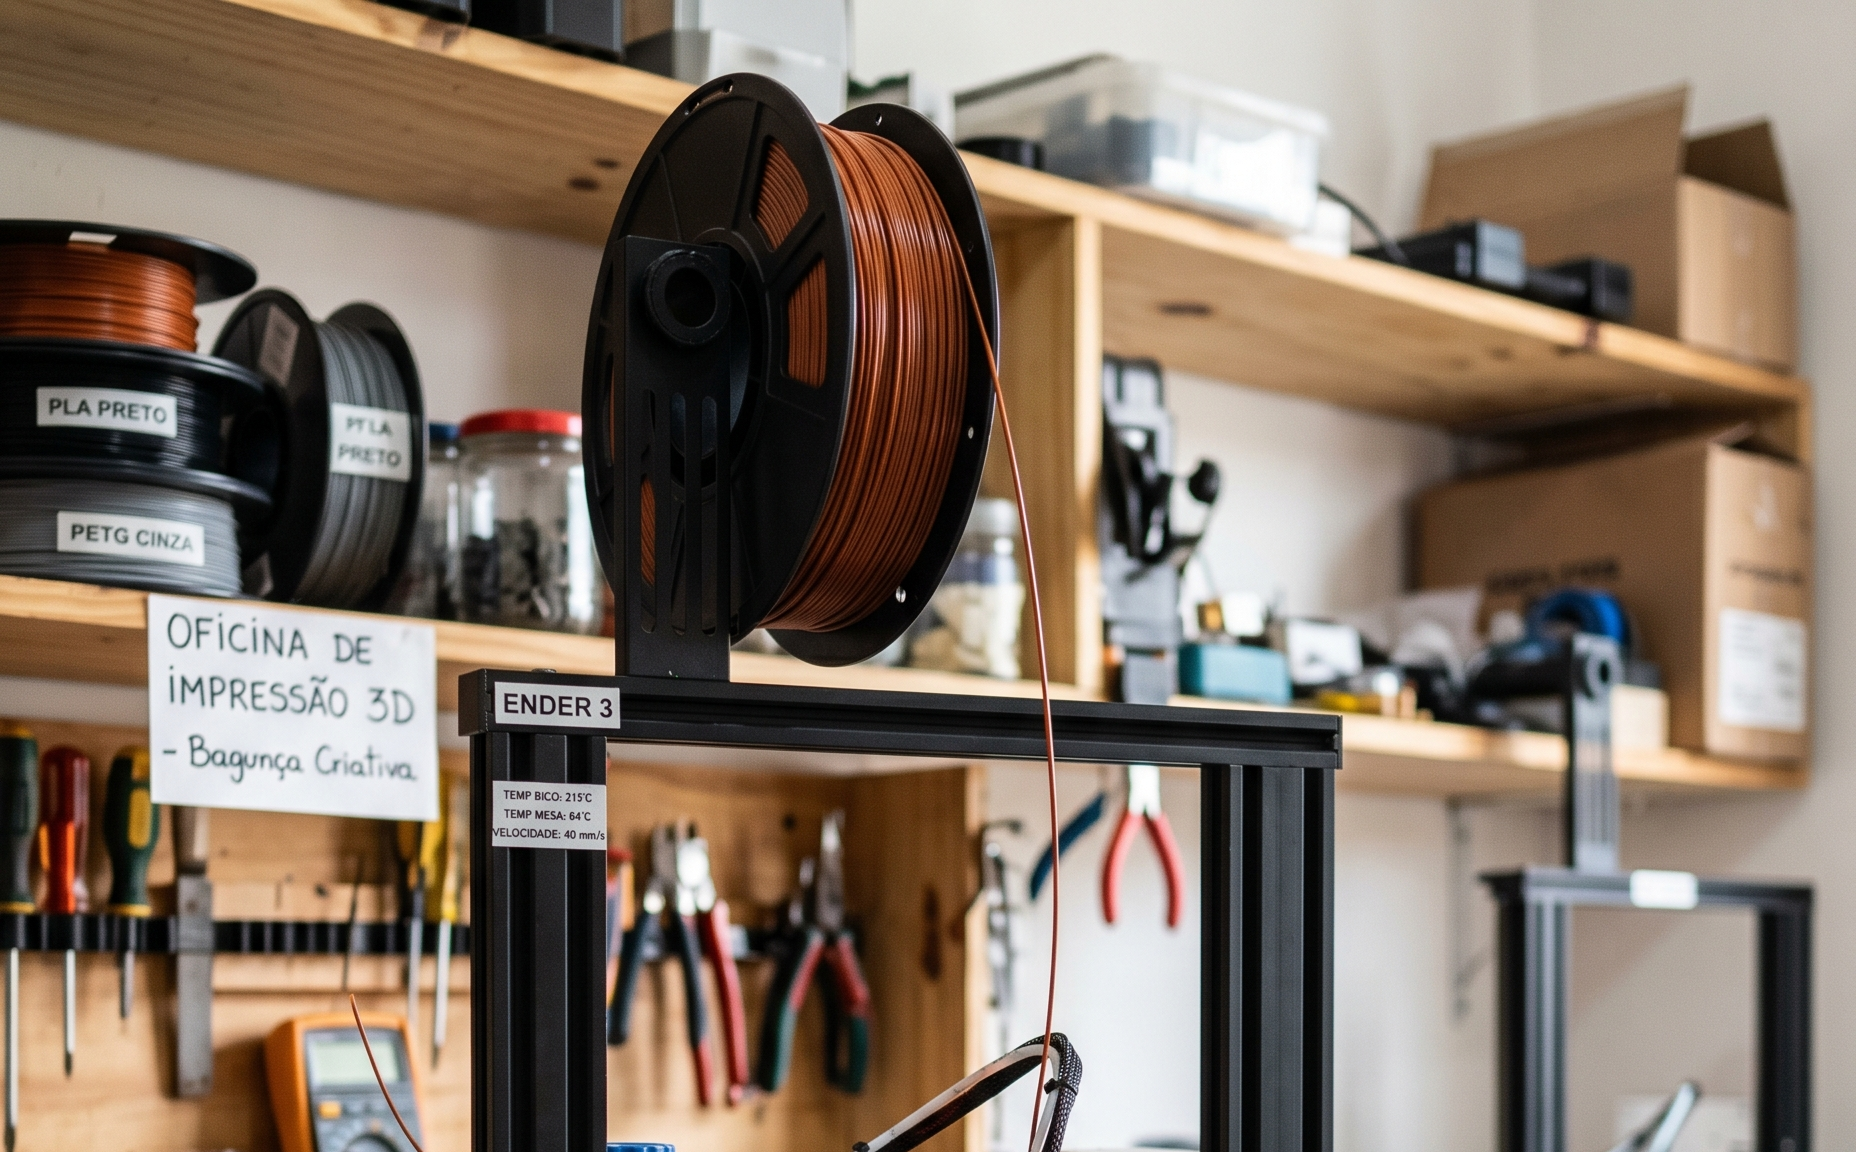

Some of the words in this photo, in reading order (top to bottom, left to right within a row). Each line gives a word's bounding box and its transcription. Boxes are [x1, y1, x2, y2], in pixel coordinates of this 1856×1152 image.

[49, 398, 91, 417] PLA
[98, 400, 167, 423] PRETO
[71, 523, 129, 544] PETG
[136, 529, 194, 551] CINZA
[167, 612, 308, 659] OFICINA
[334, 633, 373, 665] DE
[169, 665, 348, 718] IMPRESSÃO
[366, 687, 415, 724] 3D
[503, 692, 592, 717] ENDER
[599, 698, 613, 718] 3
[188, 734, 304, 783] Bagunça
[503, 789, 532, 800] TEMP
[534, 791, 562, 802] BICO:
[504, 808, 532, 819] TEMP
[535, 810, 566, 821] MESA:
[492, 827, 561, 839] VELOCIDADE:
[564, 829, 577, 840] 40
[579, 830, 606, 841] mm/s
